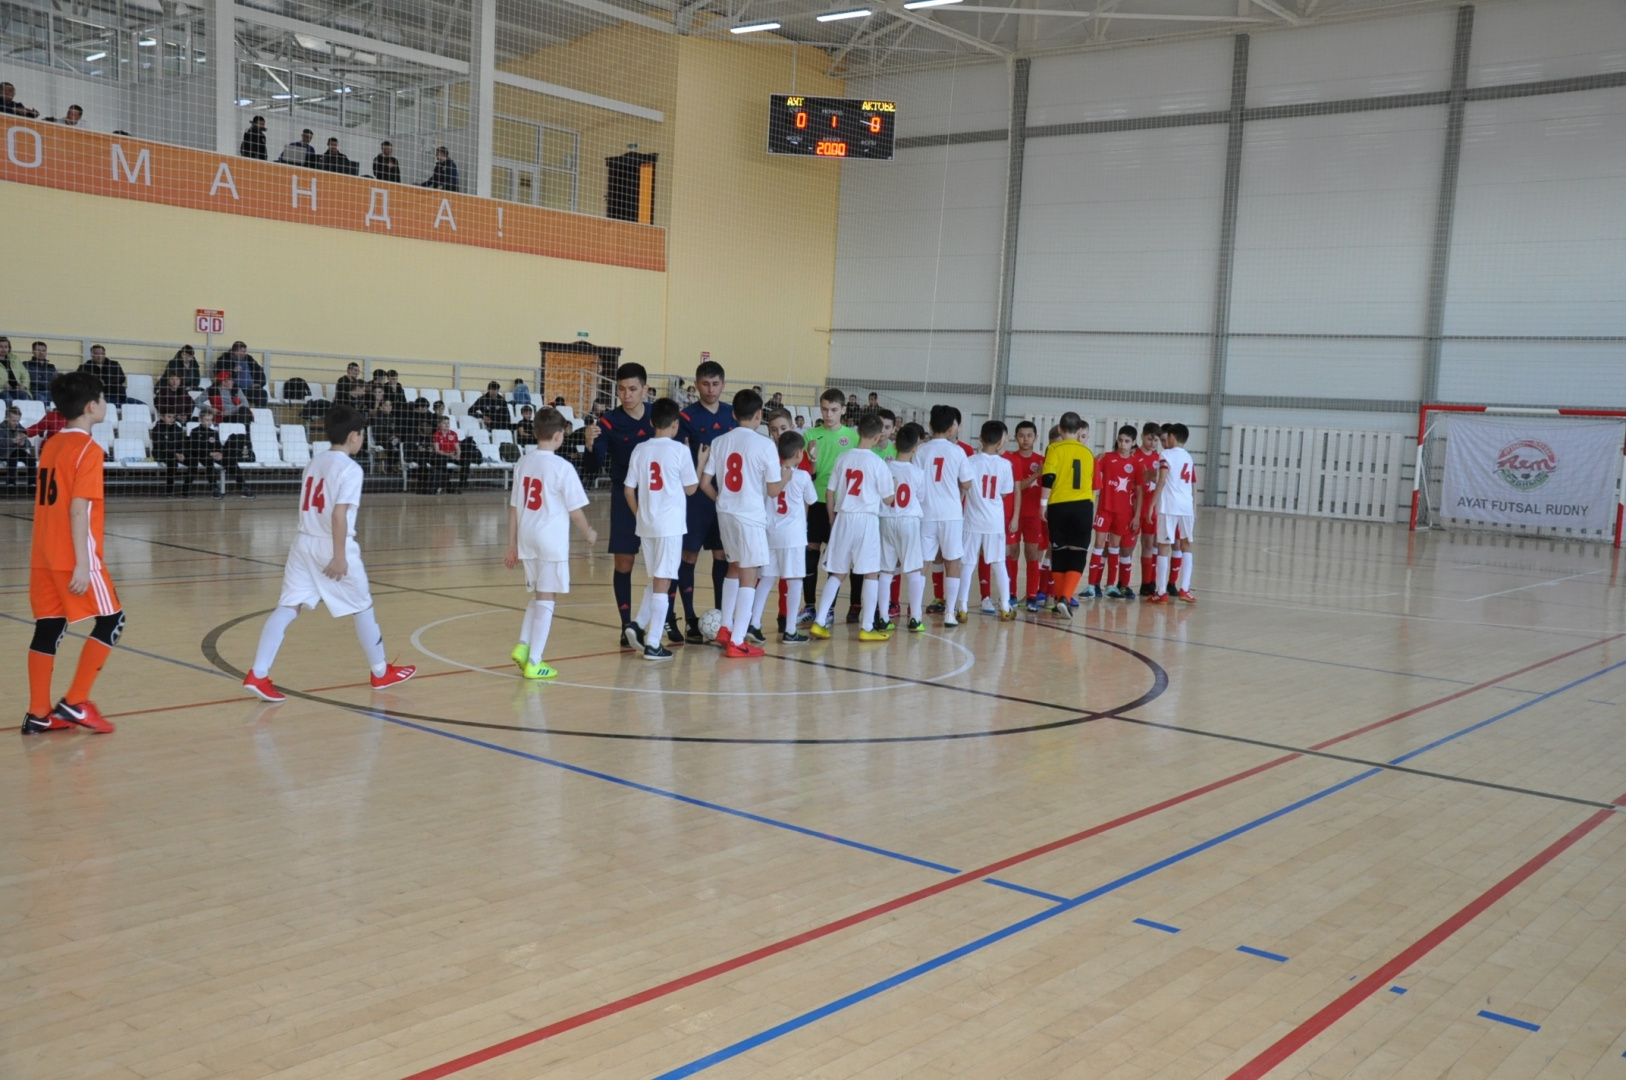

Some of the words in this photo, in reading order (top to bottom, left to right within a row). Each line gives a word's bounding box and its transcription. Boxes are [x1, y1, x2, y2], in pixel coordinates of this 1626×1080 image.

[796, 112, 807, 129] 0
[37, 467, 58, 506] 16
[649, 461, 663, 491] 3
[724, 453, 743, 492] 8
[981, 475, 997, 499] 11
[1072, 459, 1081, 490] 1
[1180, 463, 1191, 483] 4
[302, 476, 325, 513] 14
[523, 477, 543, 511] 13
[776, 491, 788, 515] 5
[1457, 496, 1488, 509] AYAT
[1492, 501, 1541, 514] FUTSAL
[1545, 504, 1589, 516] RUDNY
